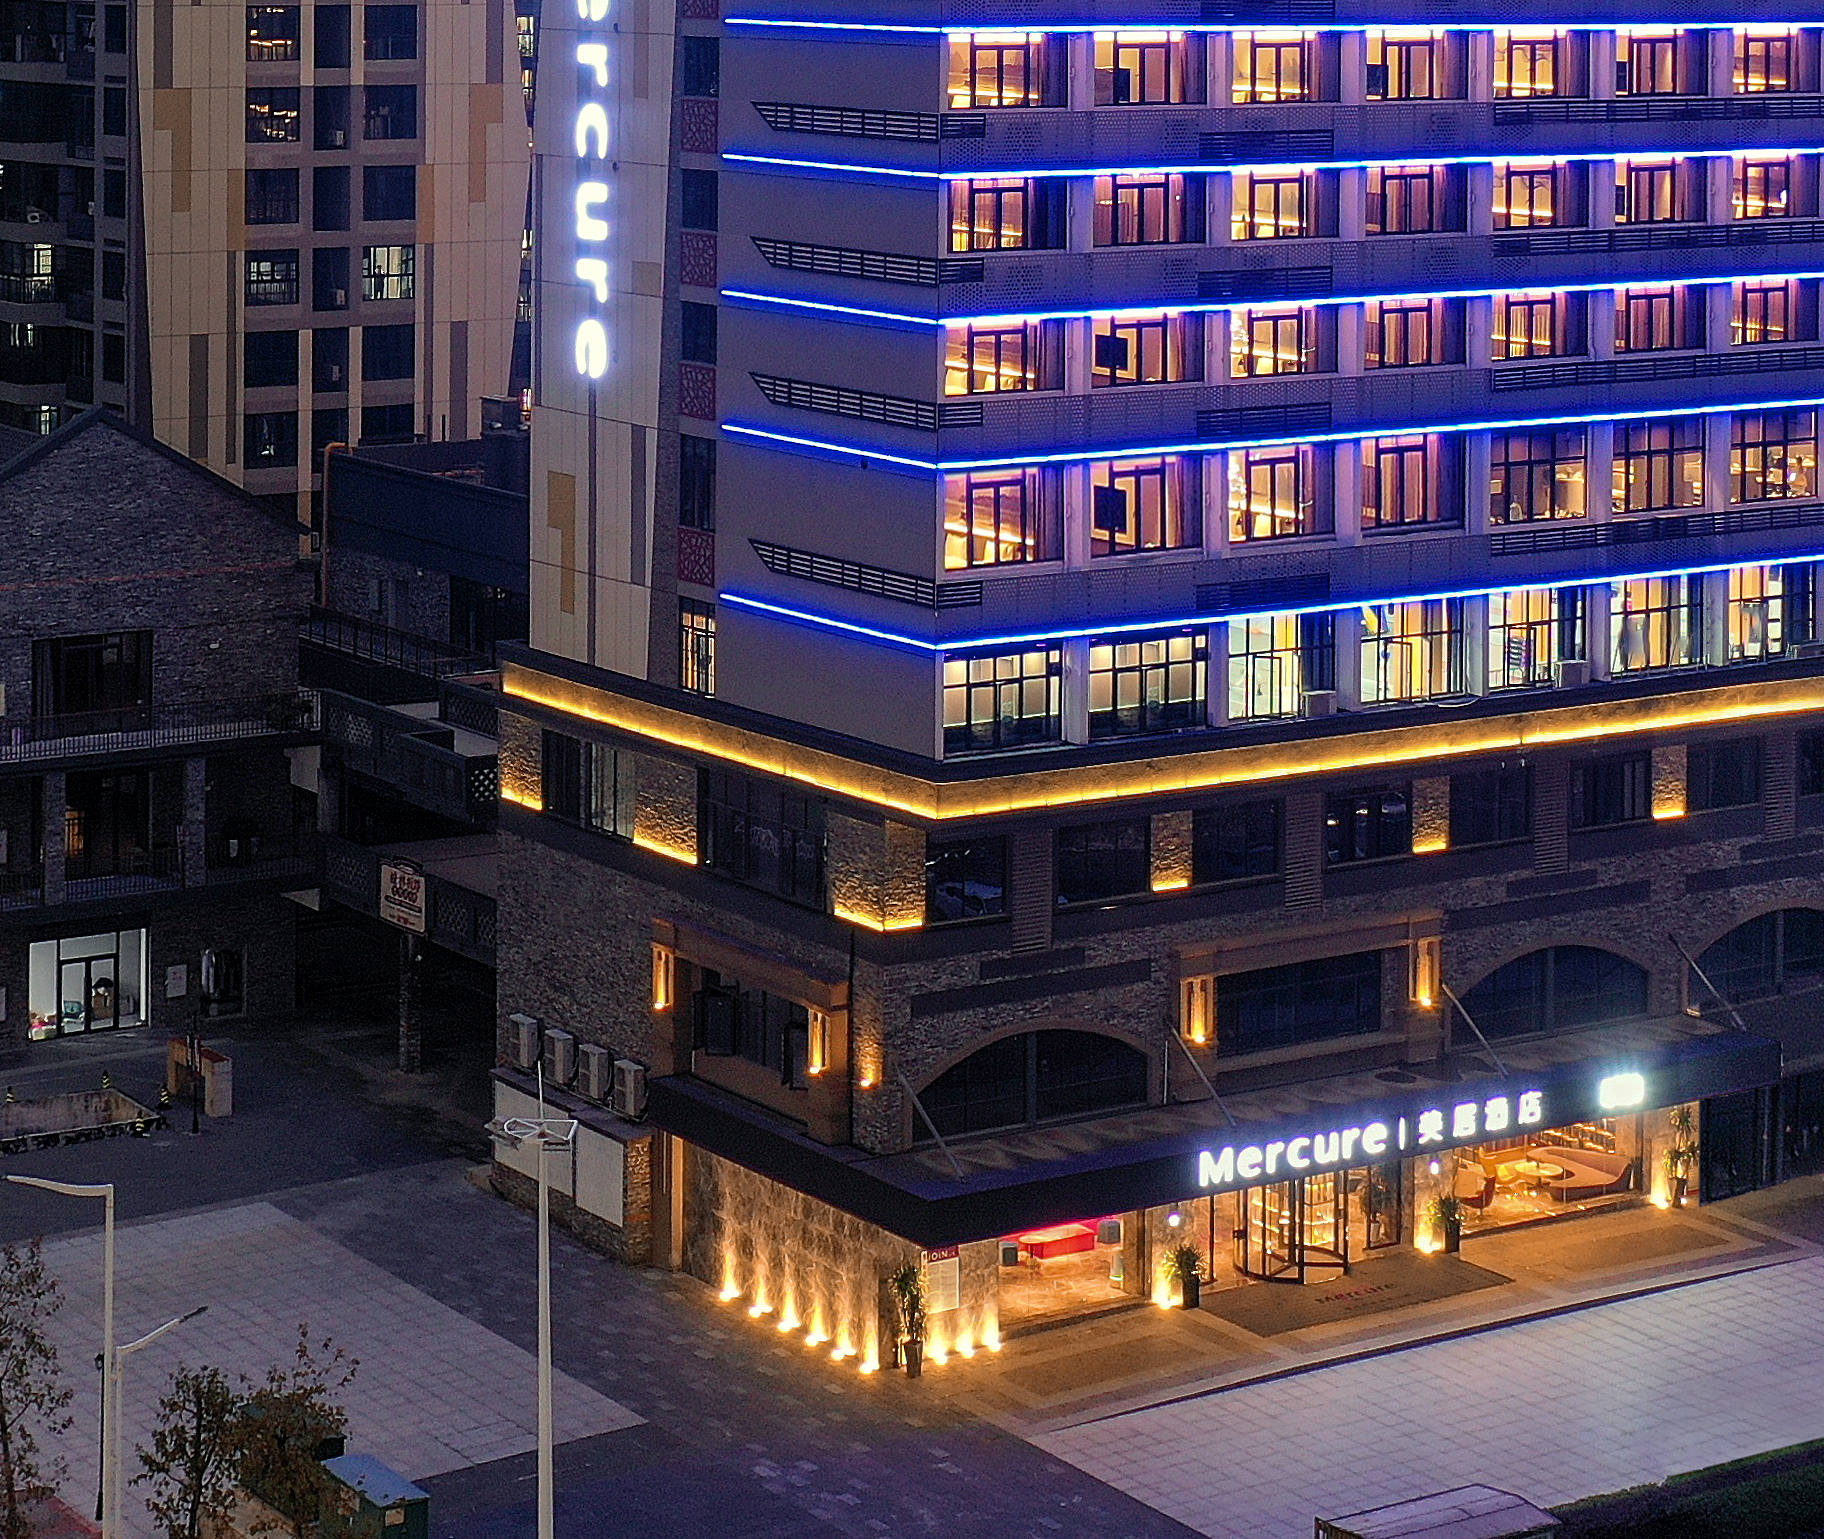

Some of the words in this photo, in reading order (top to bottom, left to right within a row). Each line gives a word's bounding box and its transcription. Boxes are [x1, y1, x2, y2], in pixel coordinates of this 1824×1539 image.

[1198, 1121, 1390, 1188] Mercure
[1417, 1089, 1544, 1146] 美居酒店
